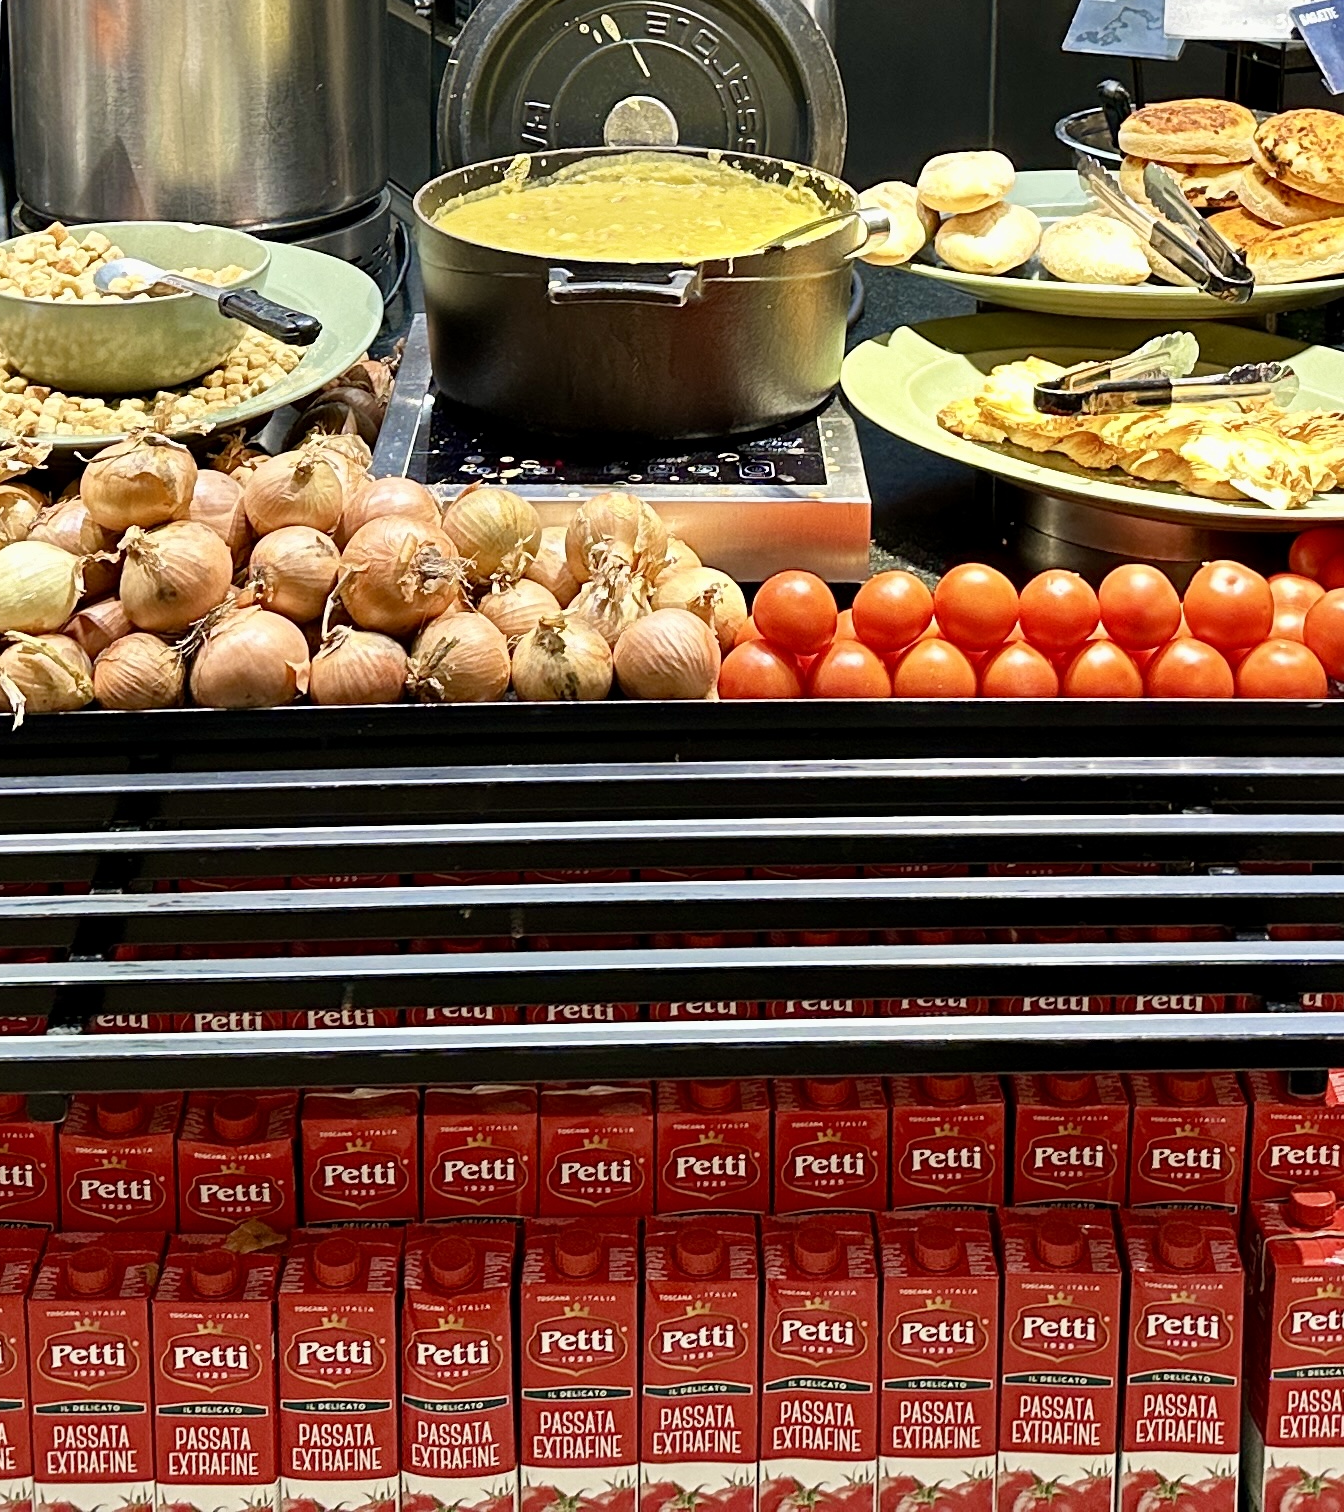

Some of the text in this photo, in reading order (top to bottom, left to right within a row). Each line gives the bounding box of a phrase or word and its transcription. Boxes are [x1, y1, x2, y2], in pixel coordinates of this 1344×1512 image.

[1299, 6, 1339, 26] BAGUETTE
[194, 1011, 262, 1032] Petti
[677, 1154, 745, 1178] Petti
[795, 1153, 863, 1177] Petti
[912, 1147, 980, 1170] Petti
[1035, 1146, 1103, 1168] Petti
[1152, 1148, 1220, 1169] Petti
[1271, 1145, 1340, 1166] Petti
[325, 1162, 395, 1186] Petti
[445, 1158, 514, 1182] Petti
[561, 1160, 630, 1184] Petti
[81, 1180, 151, 1200] Petti
[200, 1183, 270, 1202] Petti
[781, 1321, 853, 1345] Petti
[902, 1322, 974, 1344] Petti
[1023, 1317, 1095, 1341] Petti
[1146, 1315, 1218, 1339] Petti
[541, 1330, 614, 1353] Petti
[663, 1326, 734, 1352] Petti
[52, 1344, 125, 1367] Petti
[175, 1346, 248, 1369] Petti
[299, 1341, 371, 1365] Petti
[417, 1343, 489, 1365] Petti
[661, 1405, 734, 1430] PASSATA
[781, 1400, 854, 1426] PASSATA
[901, 1401, 974, 1424] PASSATA
[1020, 1396, 1094, 1420] PASSATA
[1144, 1394, 1217, 1418] PASSATA
[418, 1421, 492, 1445] PASSATA
[541, 1411, 615, 1434] PASSATA
[1012, 1421, 1101, 1445] EXTRAFINE
[1136, 1419, 1224, 1444] EXTRAFINE
[54, 1425, 129, 1448] PASSATA
[176, 1427, 251, 1450] PASSATA
[299, 1424, 374, 1446] PASSATA
[534, 1435, 622, 1458] EXTRAFINE
[654, 1430, 741, 1454] EXTRAFINE
[773, 1426, 861, 1452] EXTRAFINE
[893, 1426, 981, 1449] EXTRAFINE
[47, 1451, 137, 1474] EXTRAFINE
[169, 1452, 259, 1475] EXTRAFINE
[293, 1447, 382, 1471] EXTRAFINE
[412, 1444, 500, 1469] EXTRAFINE
